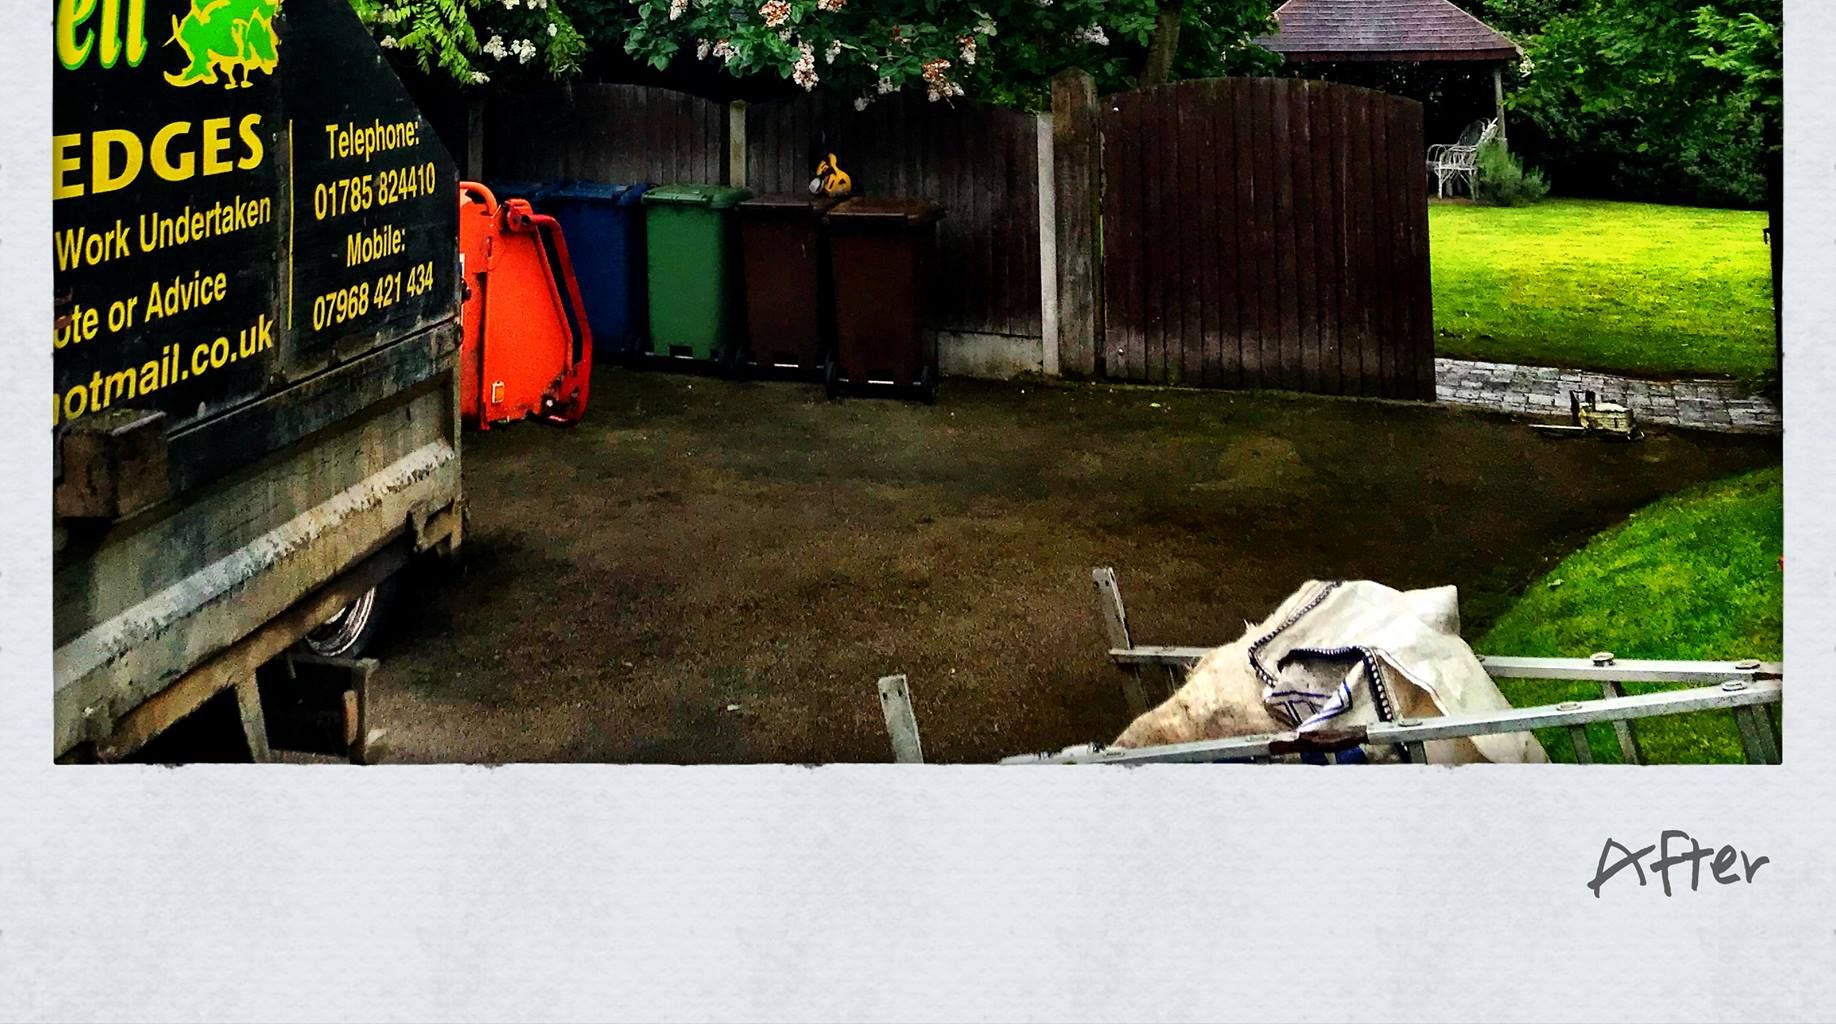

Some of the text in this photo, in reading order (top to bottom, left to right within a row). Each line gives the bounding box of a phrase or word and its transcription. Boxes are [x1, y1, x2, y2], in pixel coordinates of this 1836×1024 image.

[53, 114, 264, 200] EDGES
[326, 118, 420, 162] Telephone:
[314, 162, 436, 221] 01785 824410
[55, 195, 271, 272] Work Undertaken
[347, 228, 406, 268] Mobile:
[108, 296, 138, 332] or
[145, 272, 227, 323] Advice
[313, 261, 434, 332] 07968 421 434
